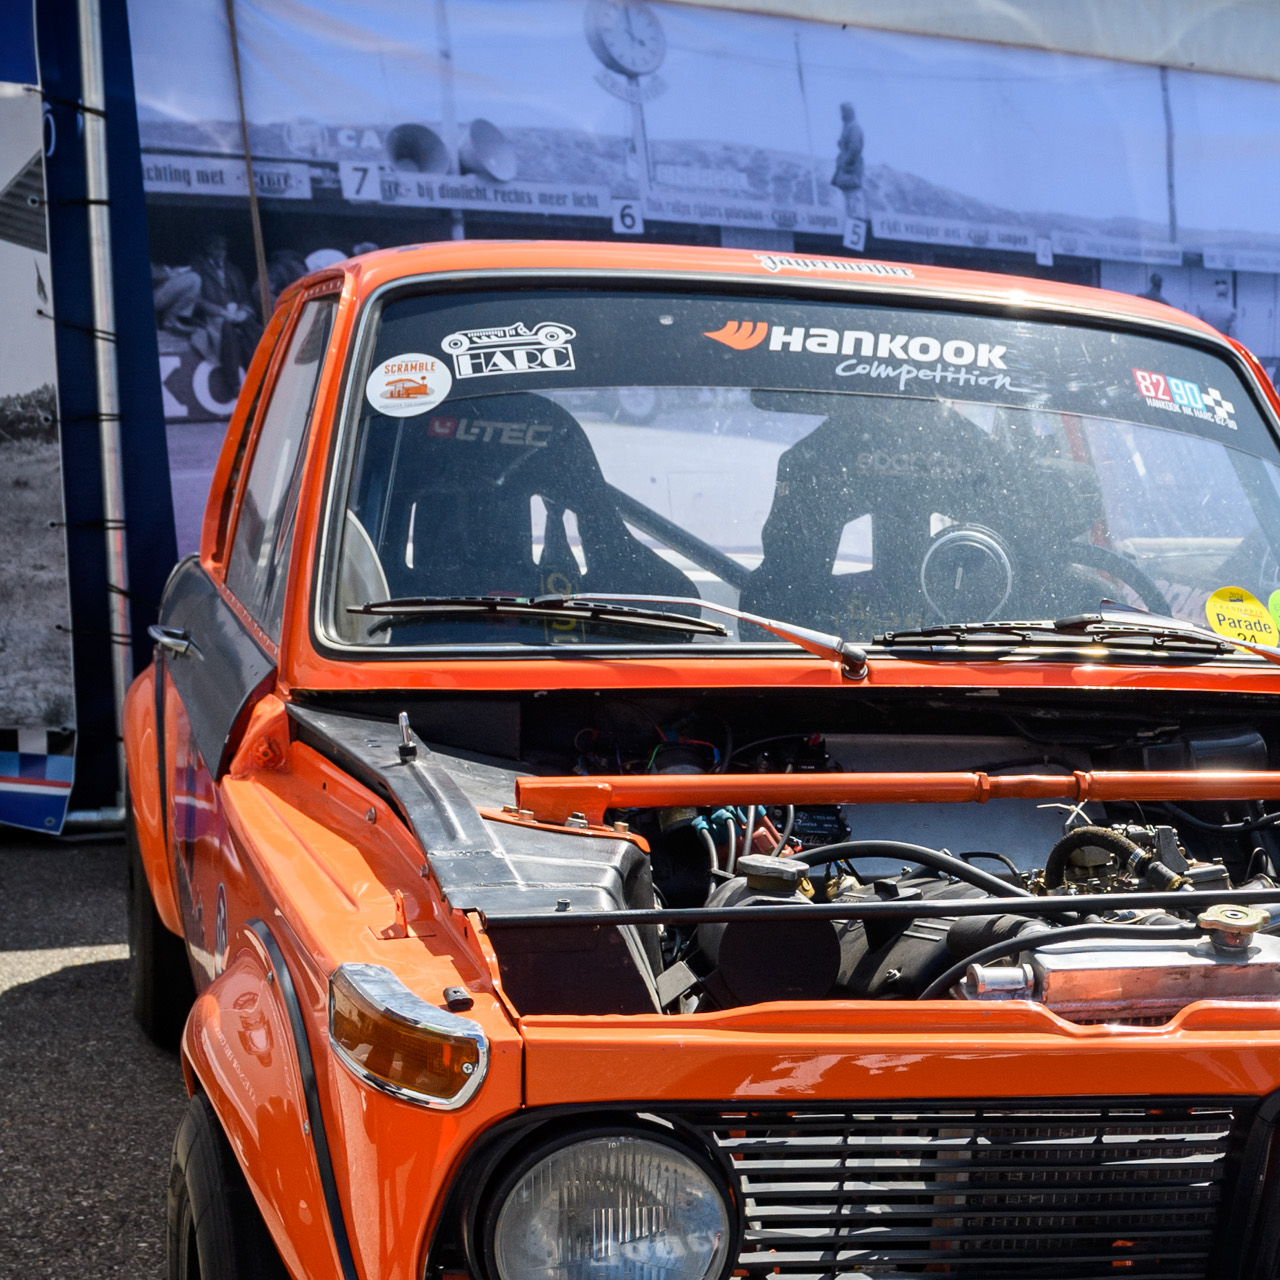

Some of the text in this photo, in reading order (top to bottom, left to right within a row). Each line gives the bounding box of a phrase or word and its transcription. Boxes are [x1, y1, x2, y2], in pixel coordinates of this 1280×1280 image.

[352, 167, 369, 196] 7
[619, 204, 636, 230] 6
[850, 222, 862, 247] 5
[384, 361, 436, 375] SCRAMBLE
[457, 347, 570, 376] HARC
[1145, 397, 1182, 413] HANKOOK
[1215, 612, 1273, 634] Parade
